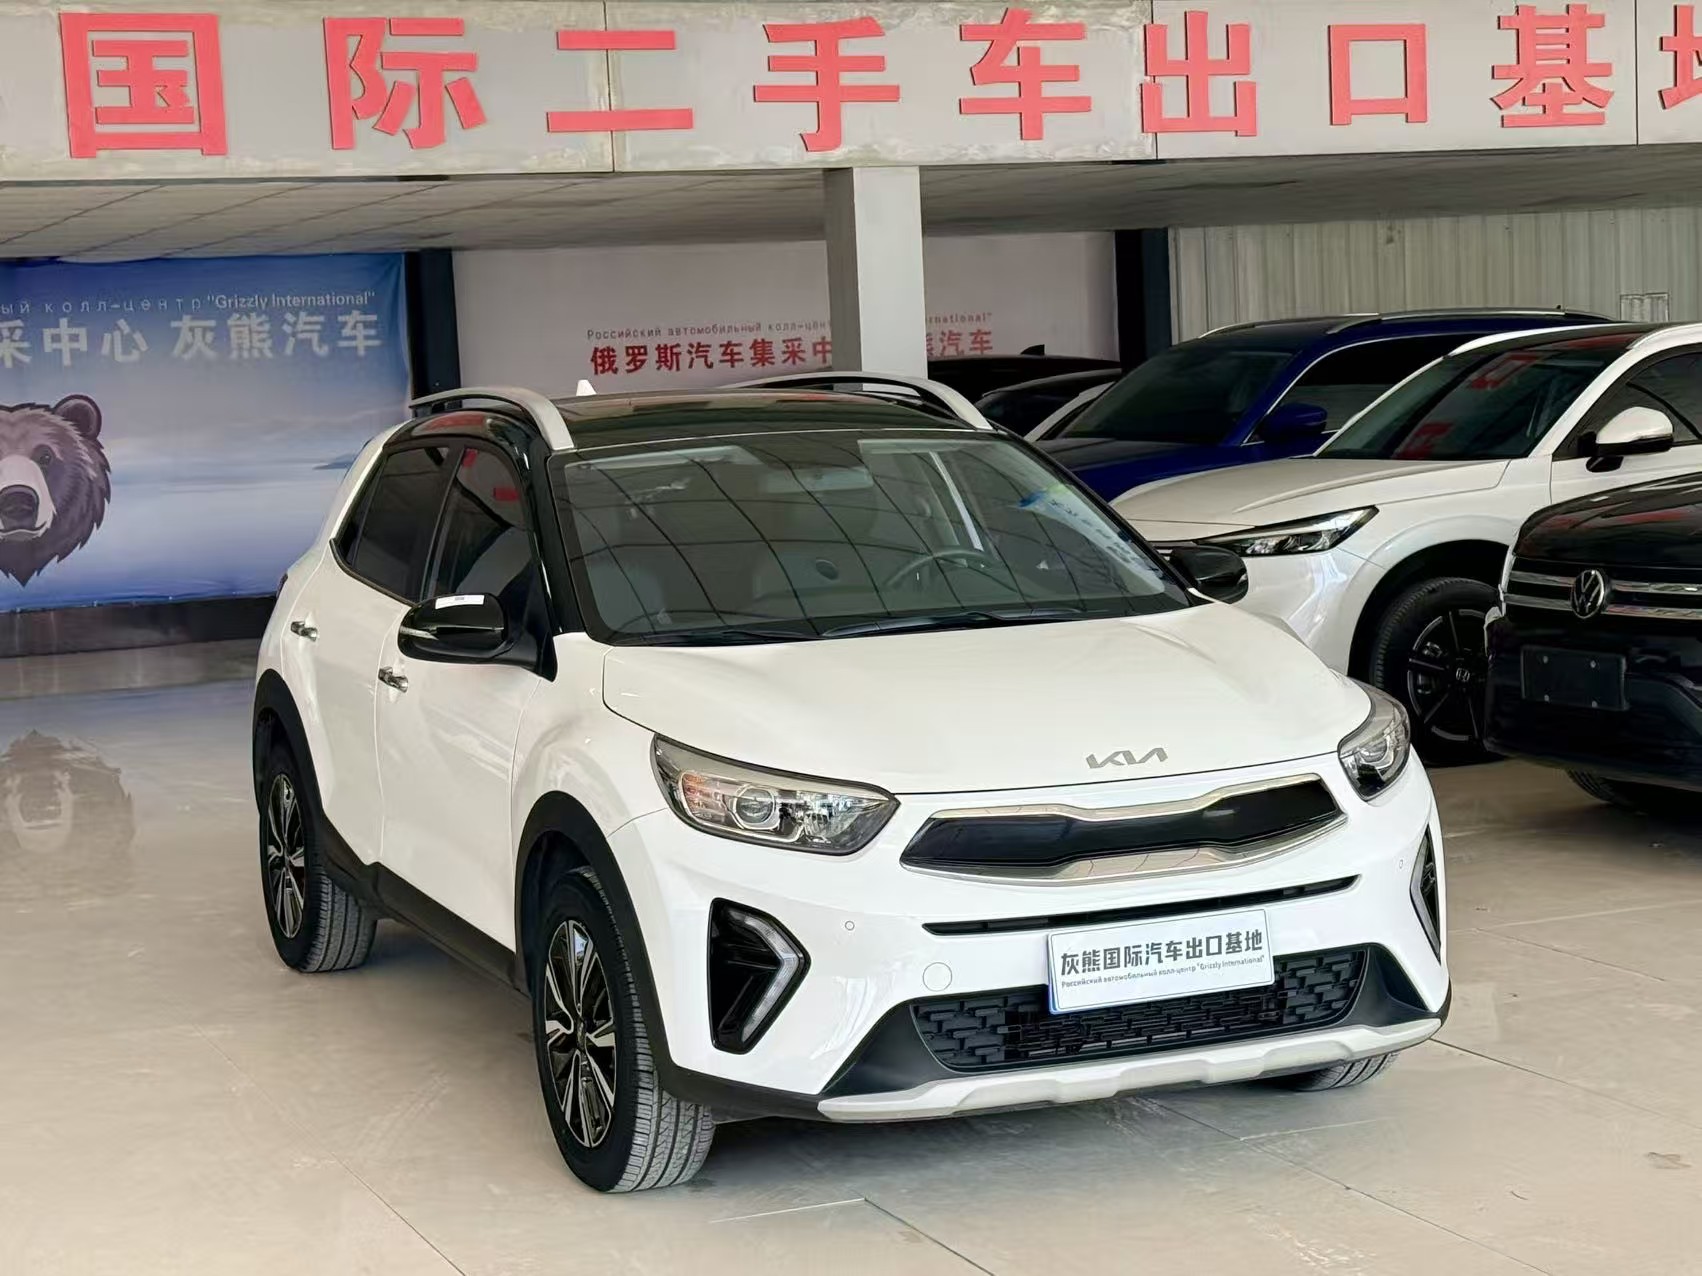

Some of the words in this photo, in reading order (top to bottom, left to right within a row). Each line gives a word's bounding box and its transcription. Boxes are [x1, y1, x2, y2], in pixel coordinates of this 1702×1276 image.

[207, 294, 267, 310] "Grizzly
[272, 292, 375, 308] International"
[170, 309, 382, 361] 灰熊汽车
[587, 328, 662, 341] Российский
[667, 322, 762, 337] автомобильный
[925, 312, 993, 324] rnational"
[1060, 929, 1263, 976] 灰熊国际汽车出口基地
[1061, 976, 1103, 988] Российский
